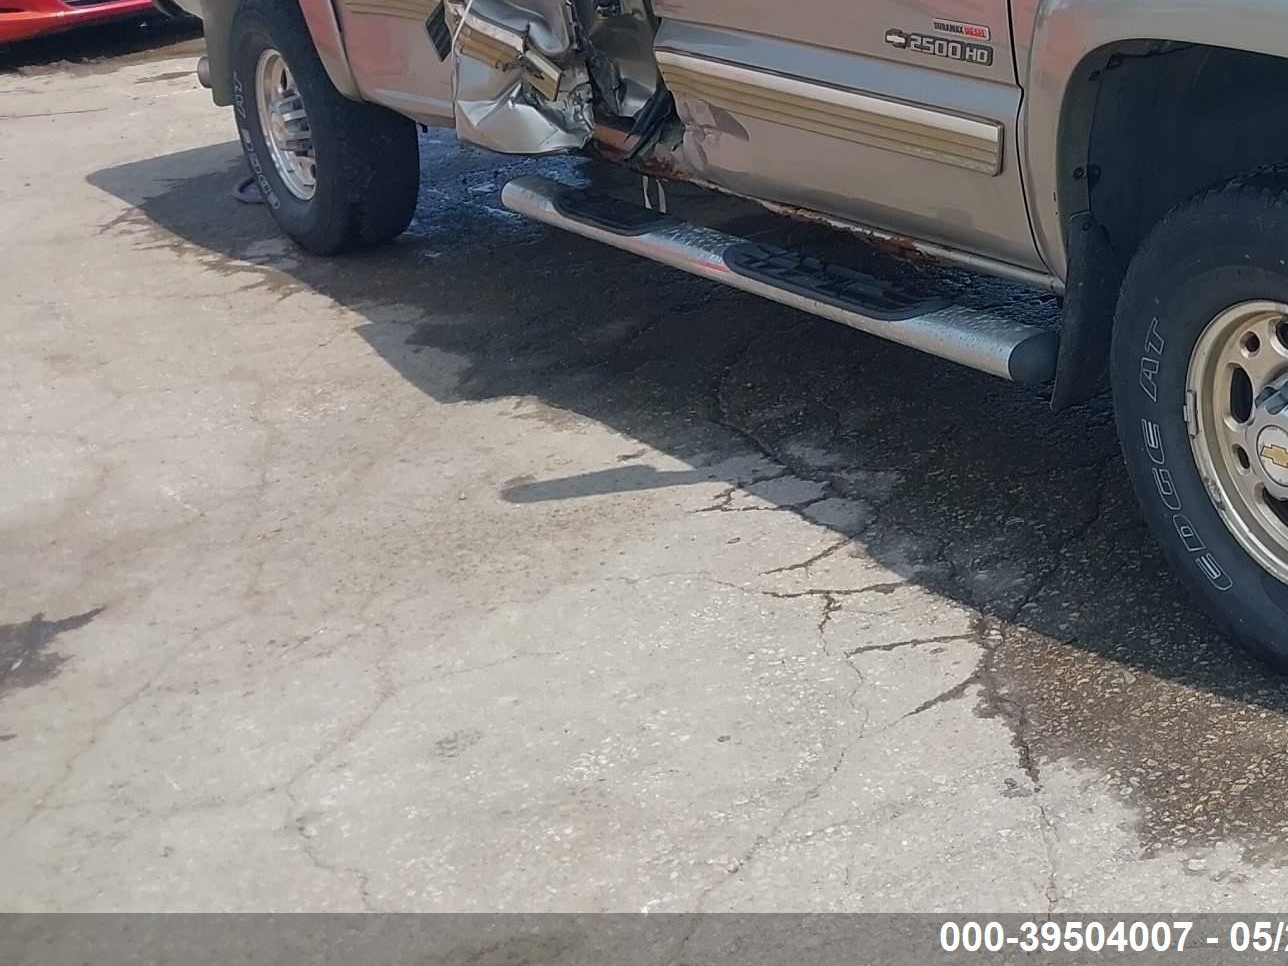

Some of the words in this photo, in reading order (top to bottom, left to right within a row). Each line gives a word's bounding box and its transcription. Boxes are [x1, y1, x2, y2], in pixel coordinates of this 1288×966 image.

[910, 34, 961, 59] 2500
[966, 46, 988, 63] HD
[933, 21, 965, 34] DURAMAX
[1139, 317, 1165, 402] AT
[1141, 418, 1233, 591] EDGE
